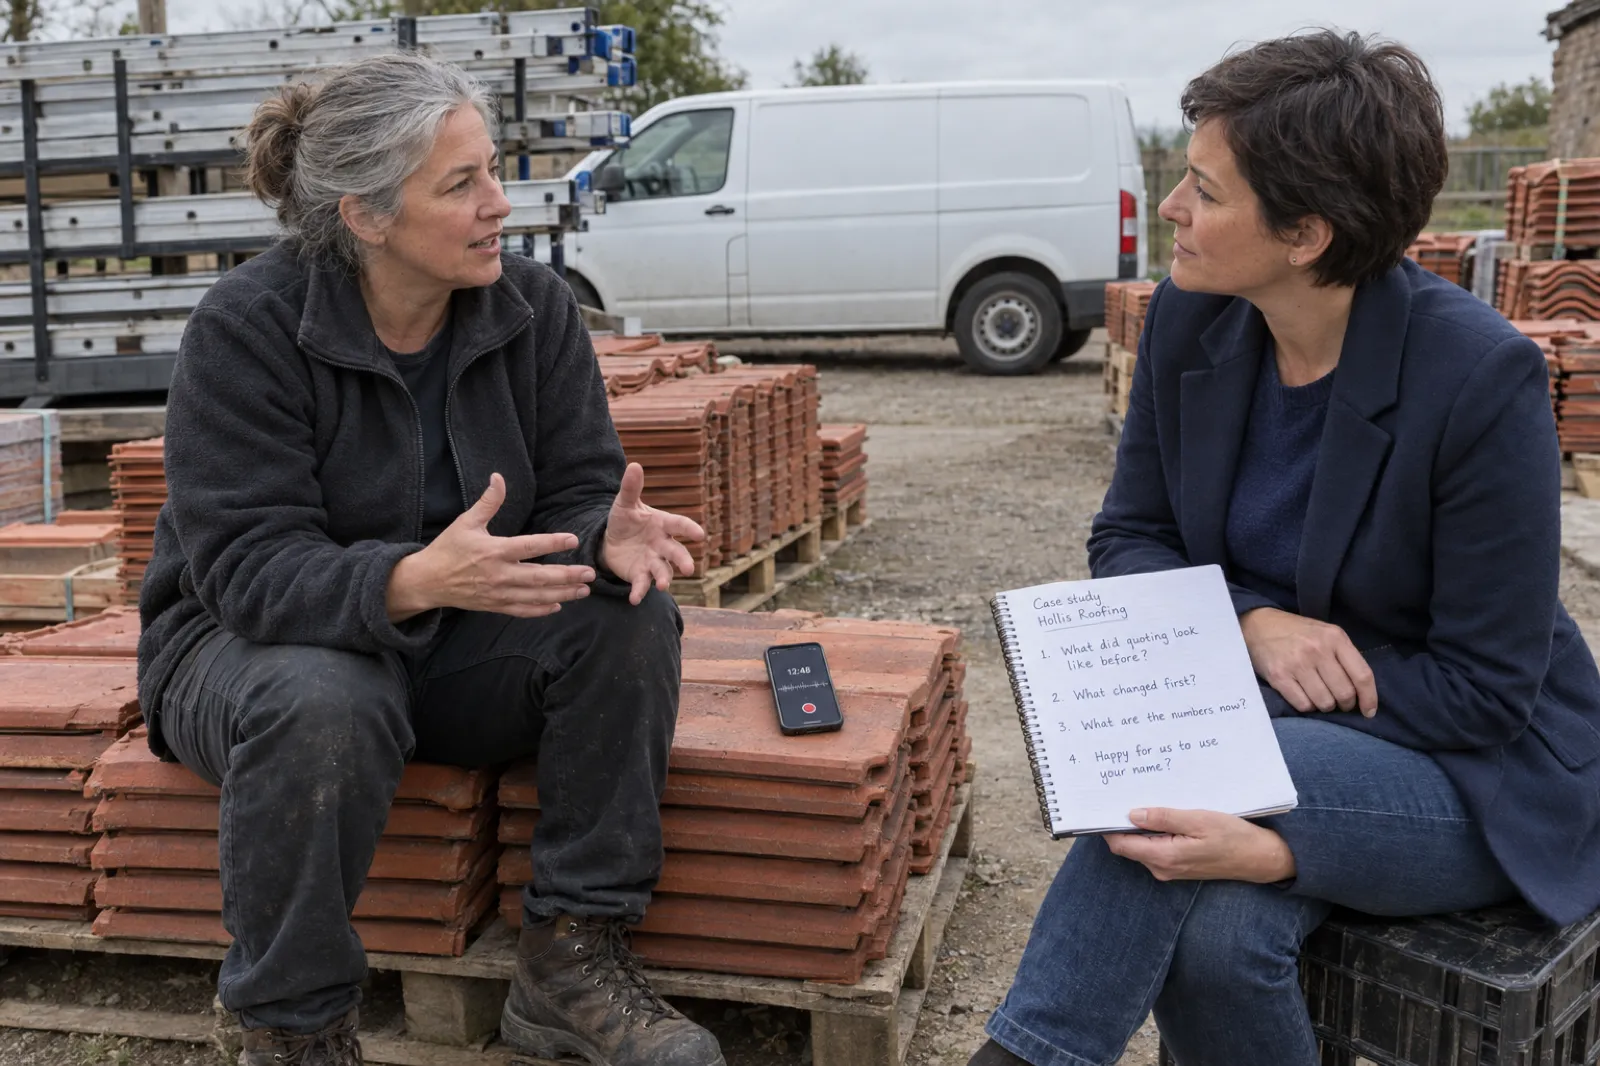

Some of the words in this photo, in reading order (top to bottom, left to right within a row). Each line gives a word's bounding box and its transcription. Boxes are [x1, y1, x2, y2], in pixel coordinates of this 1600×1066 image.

[1033, 598, 1062, 609] Case
[1067, 591, 1102, 607] study
[1038, 613, 1072, 627] Hollis
[1078, 603, 1127, 620] Roofing
[1041, 650, 1050, 659] 1.
[1061, 642, 1094, 655] What
[1101, 637, 1120, 649] did
[1127, 632, 1169, 649] quoting
[1173, 626, 1198, 637] look
[787, 666, 811, 676] 12:48
[1068, 660, 1093, 670] like
[1100, 648, 1147, 665] before?
[1052, 693, 1064, 702] 2.
[1073, 688, 1105, 700] What
[1113, 680, 1158, 697] changed
[1164, 674, 1196, 689] first?
[1058, 722, 1070, 732] 3.
[1081, 717, 1114, 730] What
[1121, 716, 1139, 725] are
[1147, 712, 1165, 722] the
[1172, 707, 1214, 719] numbers
[1220, 698, 1246, 712] now?
[1069, 754, 1080, 764] 4.
[1095, 751, 1128, 764] Happy
[1136, 744, 1152, 756] for
[1160, 745, 1172, 753] us
[1179, 741, 1191, 750] to
[1199, 738, 1218, 748] use
[1100, 769, 1125, 785] your
